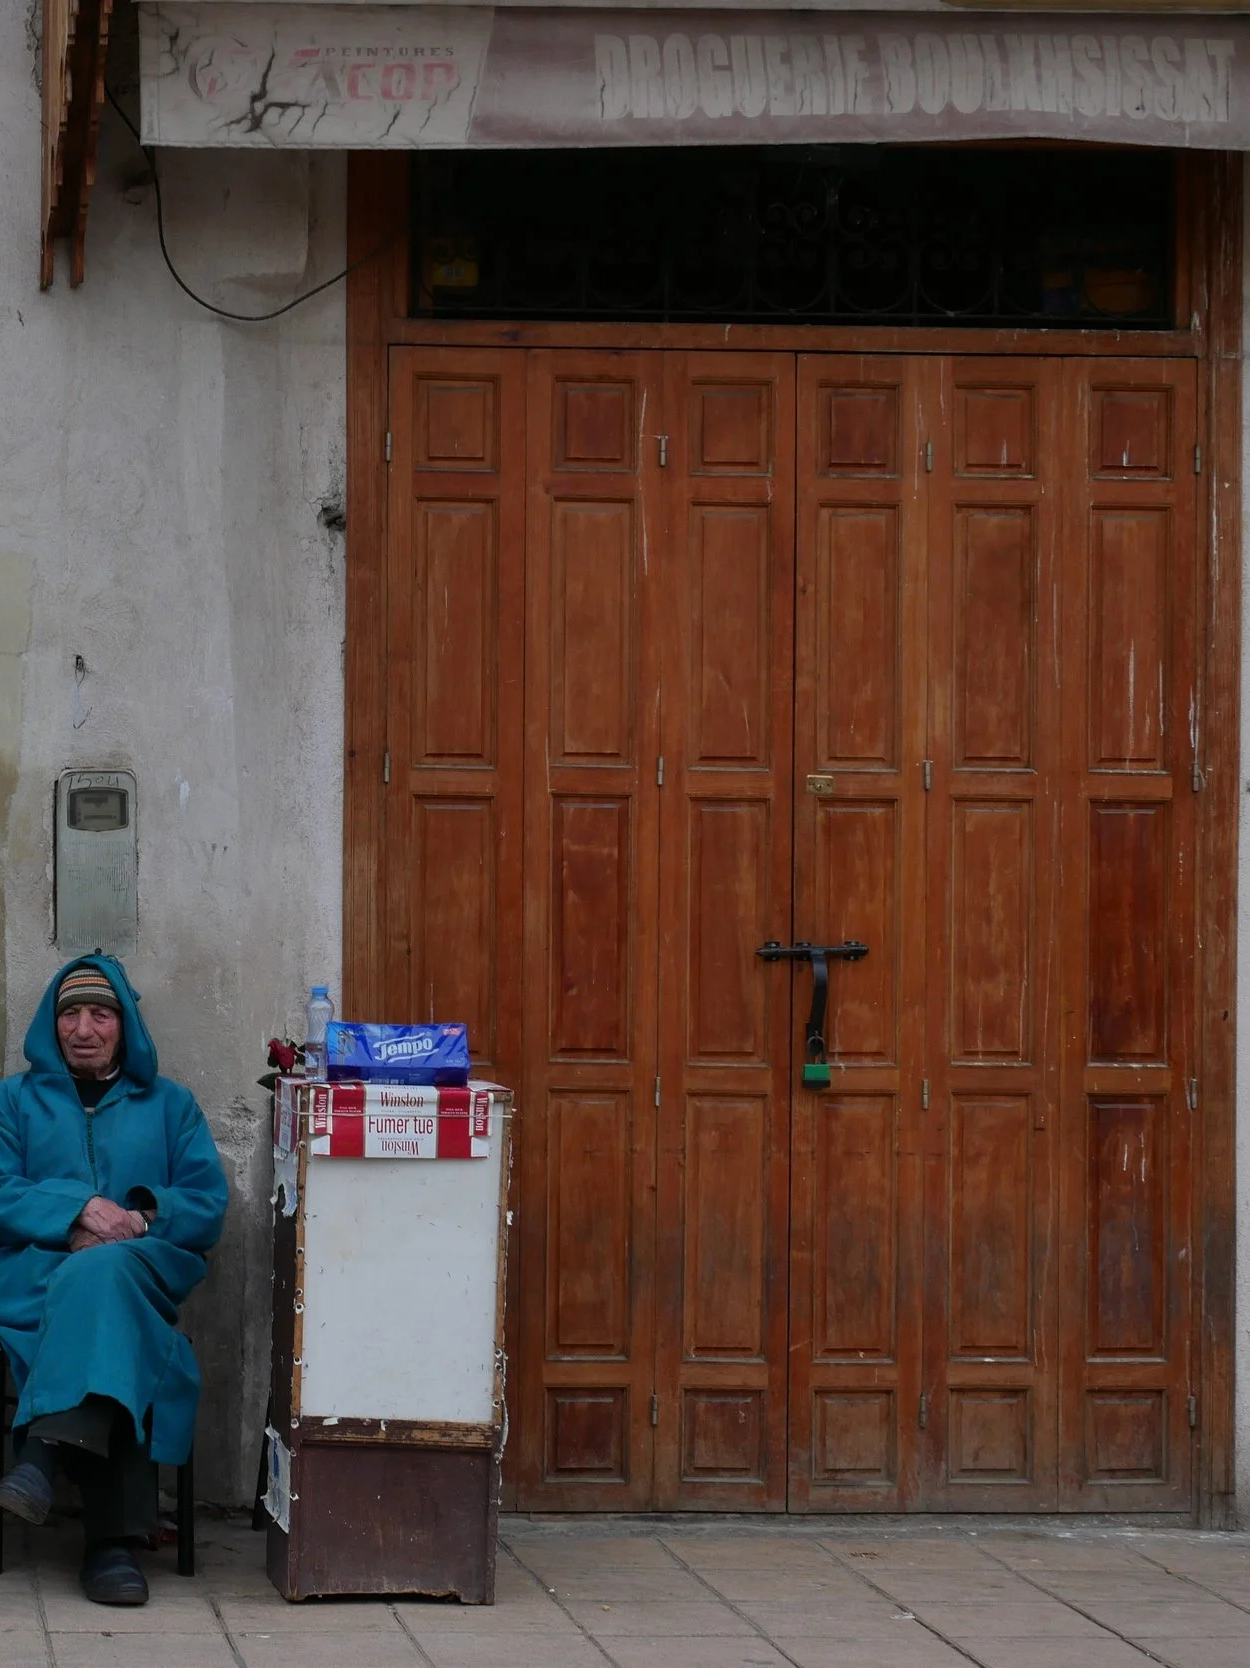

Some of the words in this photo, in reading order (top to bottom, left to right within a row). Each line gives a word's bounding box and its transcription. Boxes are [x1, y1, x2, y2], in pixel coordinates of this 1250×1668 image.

[324, 46, 455, 58] PEINTURES
[594, 32, 872, 119] DROGUERIE
[380, 1091, 424, 1108] Winston
[314, 1093, 327, 1129] Winston
[475, 1096, 488, 1132] Winston
[368, 1115, 410, 1135] Fumer
[413, 1116, 434, 1135] tue
[381, 1140, 420, 1156] Winston
